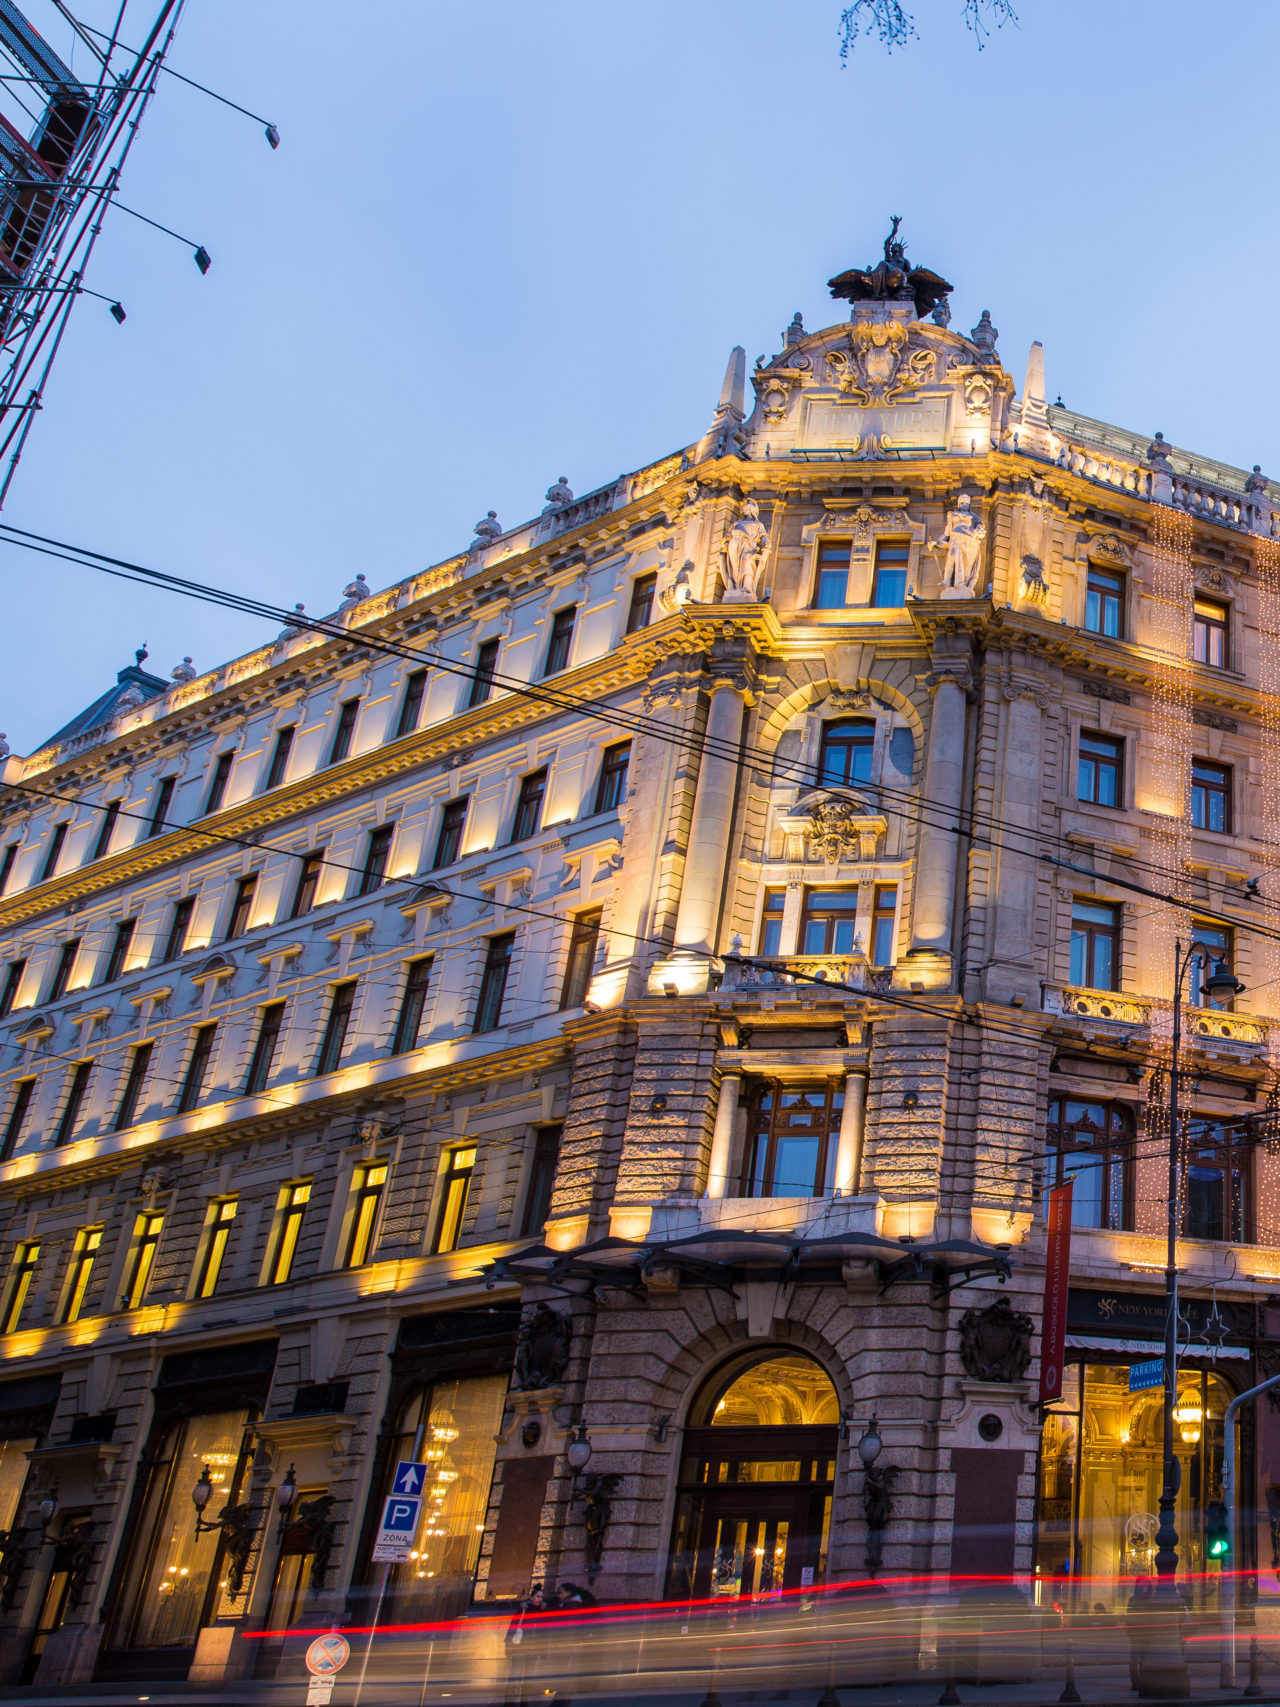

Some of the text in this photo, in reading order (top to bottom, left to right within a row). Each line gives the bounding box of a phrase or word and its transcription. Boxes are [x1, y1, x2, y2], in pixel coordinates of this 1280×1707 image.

[812, 409, 940, 435] NEW YORK
[1118, 1304, 1142, 1315] NEW
[1130, 1361, 1163, 1377] PARKING
[391, 1505, 411, 1525] P
